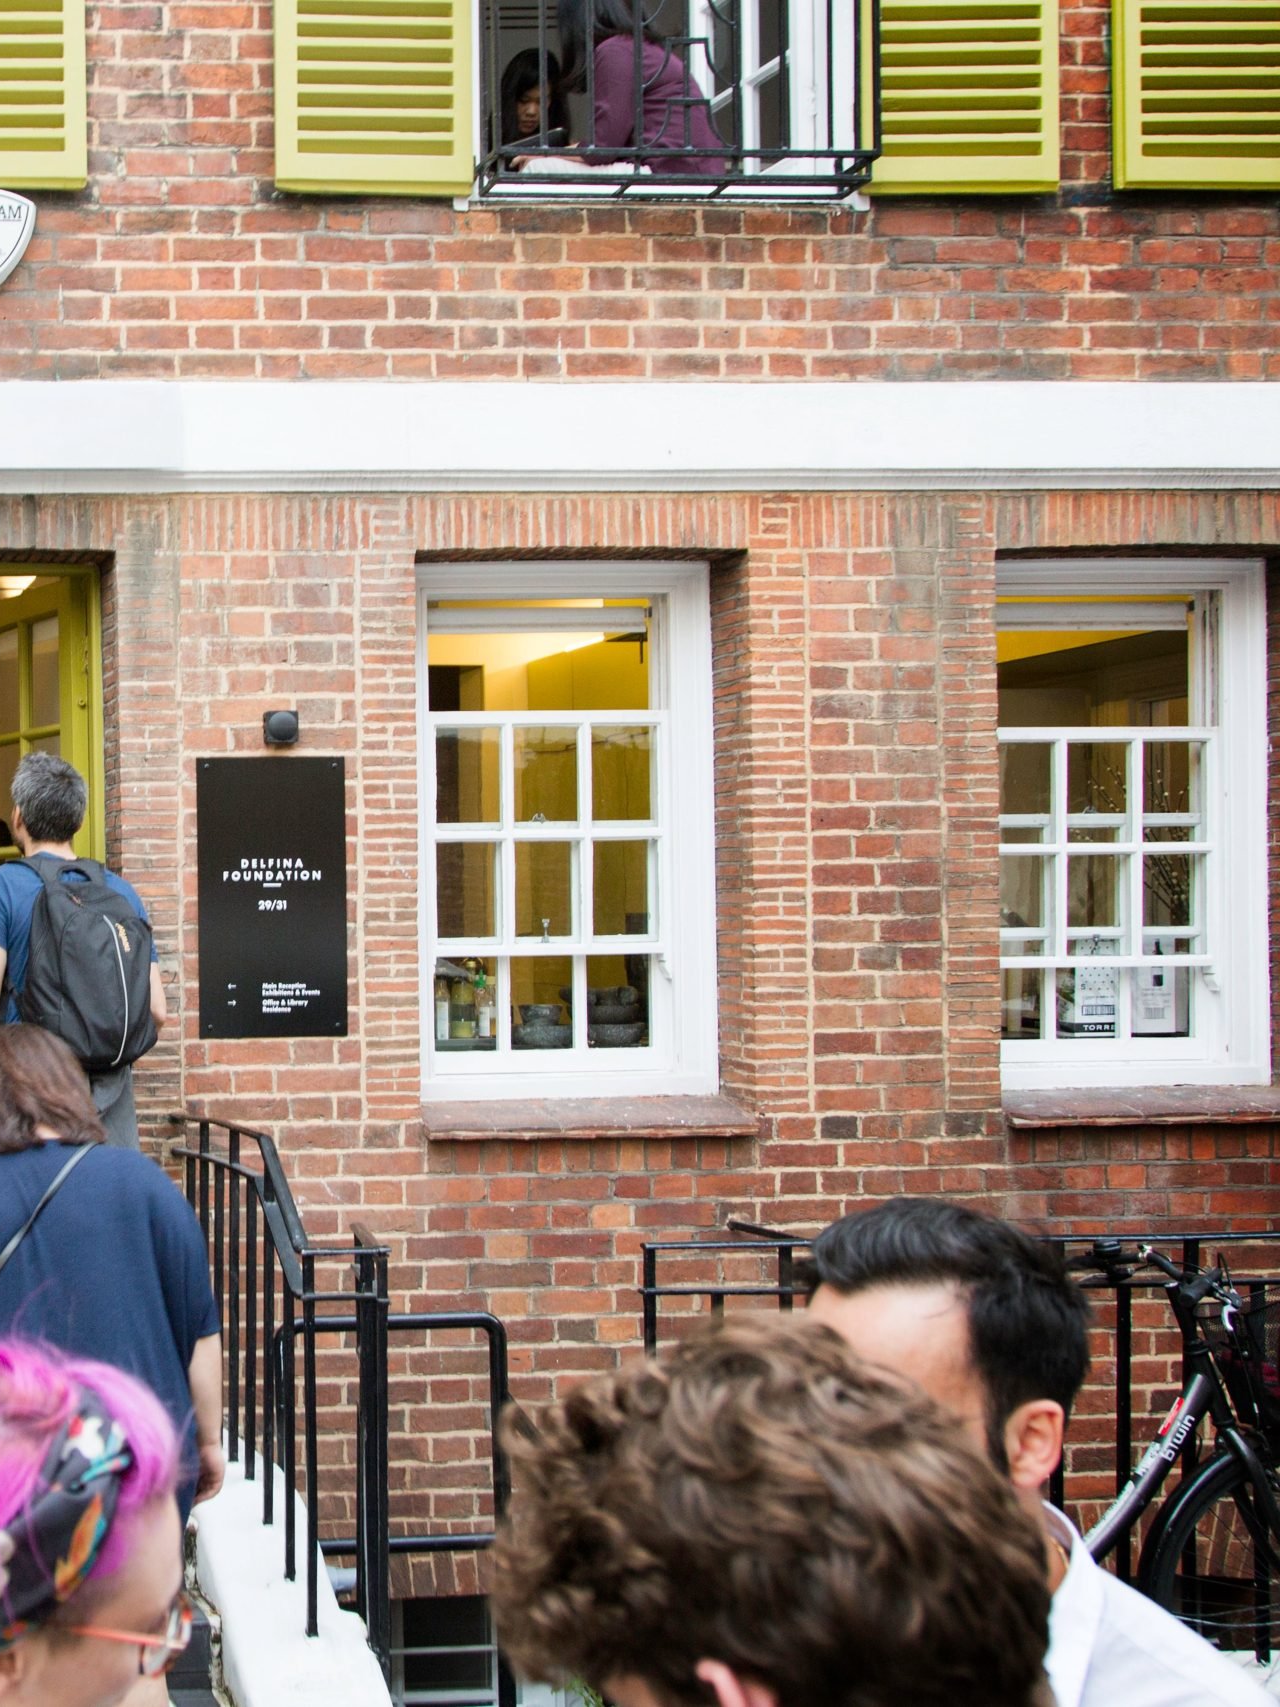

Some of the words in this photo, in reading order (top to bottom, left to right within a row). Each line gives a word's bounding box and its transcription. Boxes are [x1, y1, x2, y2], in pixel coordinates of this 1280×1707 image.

[241, 858, 303, 869] DELFINA
[223, 870, 321, 881] FOUNDATION
[258, 900, 287, 911] 29/31
[278, 982, 306, 990] Reception
[287, 999, 308, 1007] Library
